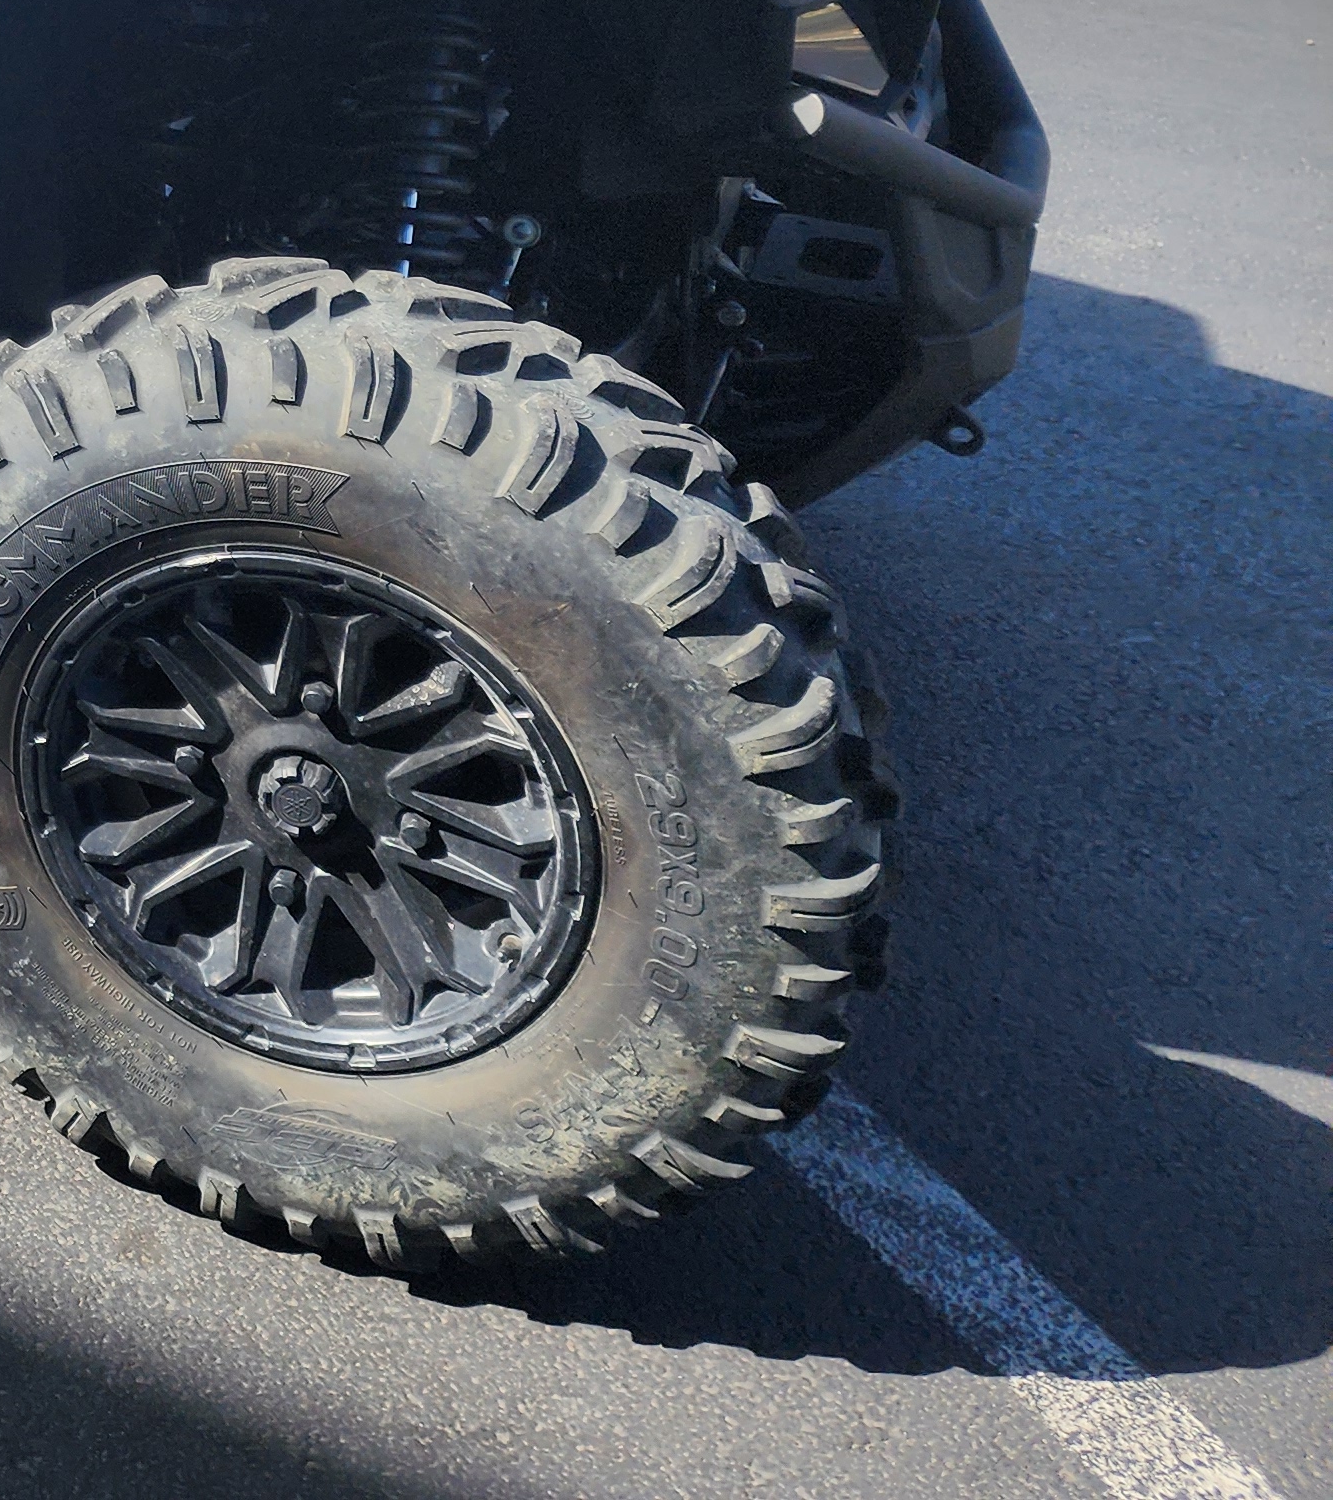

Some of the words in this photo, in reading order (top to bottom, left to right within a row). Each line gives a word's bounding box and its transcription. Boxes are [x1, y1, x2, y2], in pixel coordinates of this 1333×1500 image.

[62, 936, 84, 962] USE
[83, 962, 136, 1015] HIGHWAY
[138, 1009, 166, 1034] FOR
[167, 1030, 197, 1054] NOT
